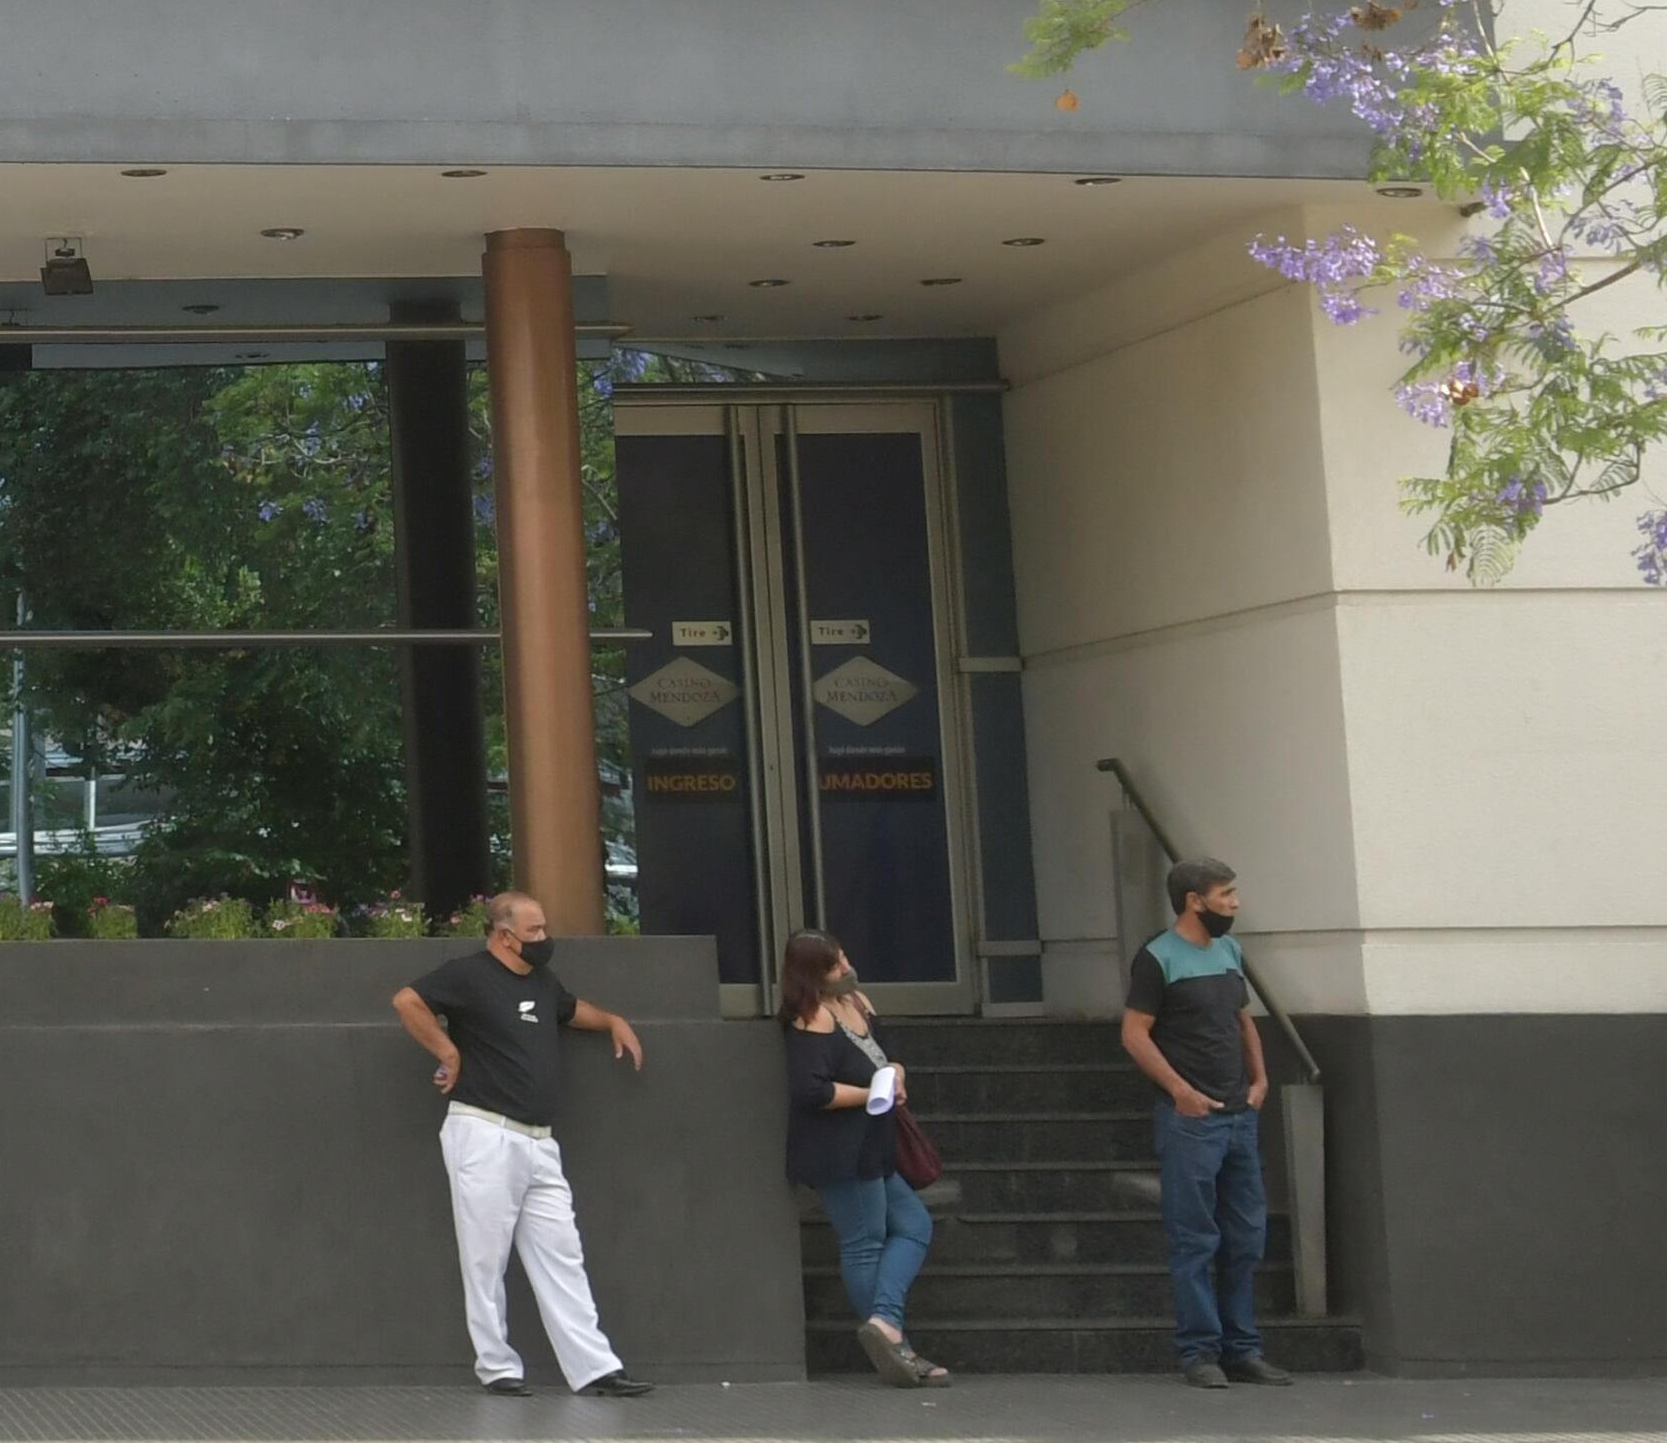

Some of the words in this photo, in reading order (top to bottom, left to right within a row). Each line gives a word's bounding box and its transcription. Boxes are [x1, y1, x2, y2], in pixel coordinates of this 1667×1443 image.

[680, 627, 706, 639] Tire
[818, 626, 844, 637] Tire
[650, 691, 721, 703] MENDOZA
[827, 690, 898, 703] MENDOZA
[647, 774, 737, 791] INGRESO
[817, 773, 932, 791] UMADORES
